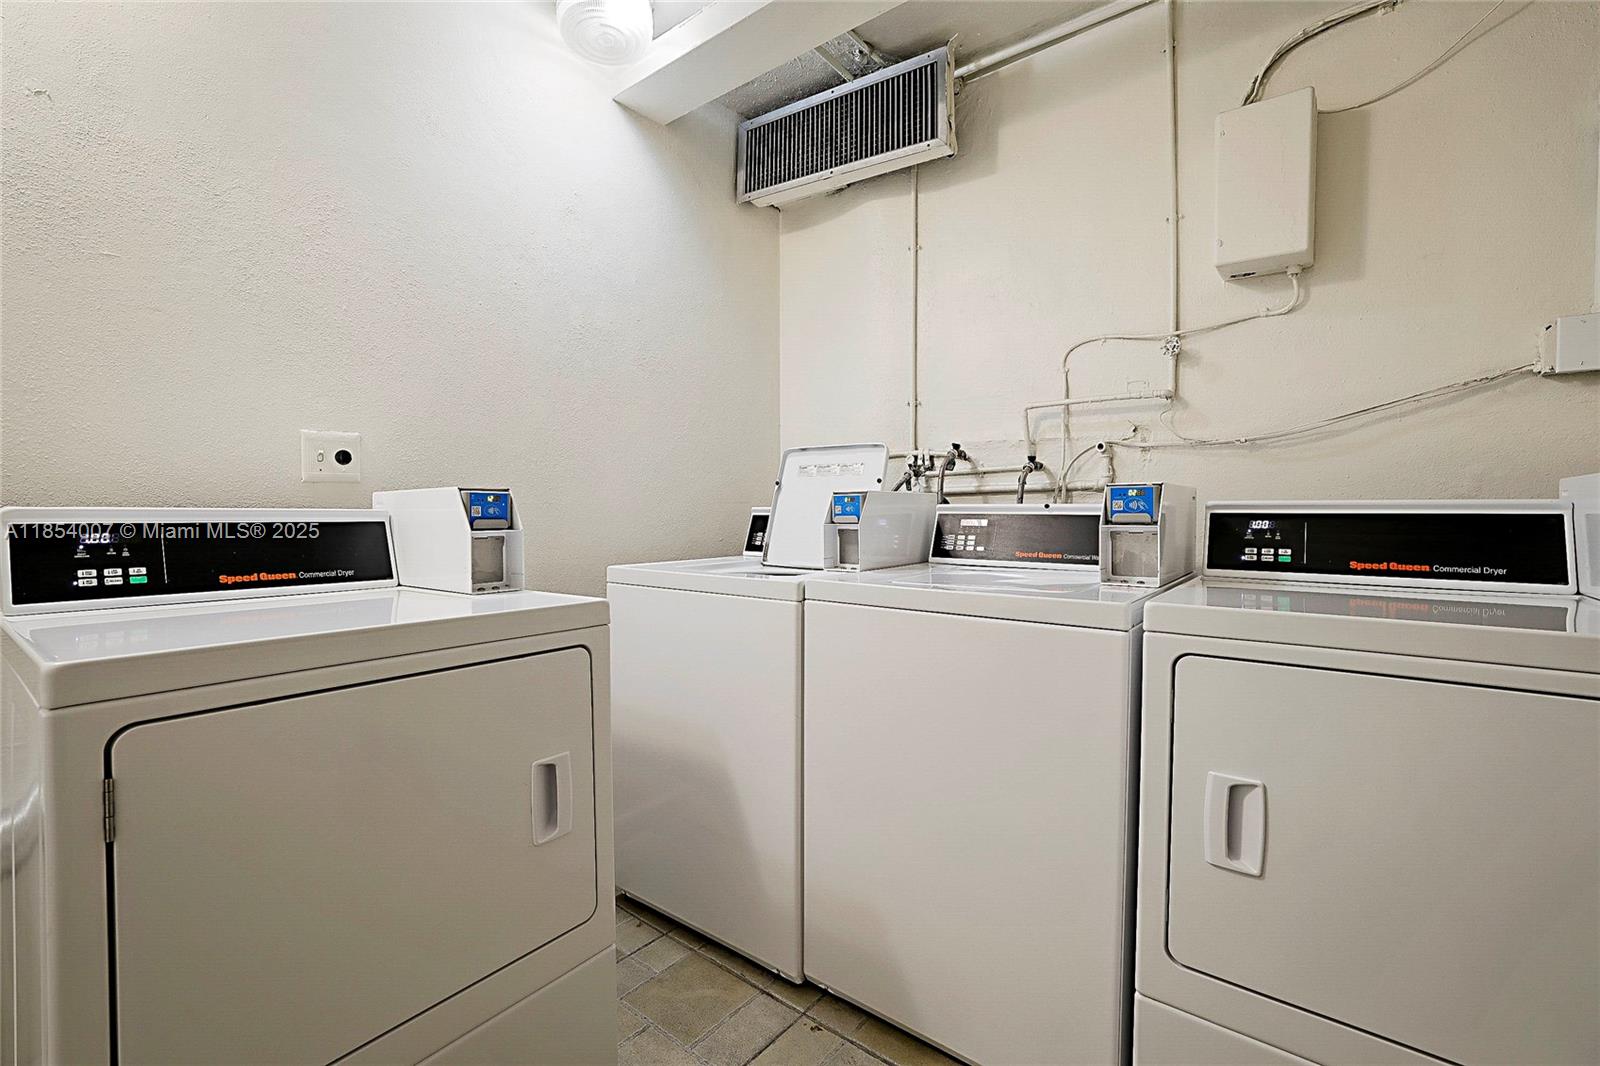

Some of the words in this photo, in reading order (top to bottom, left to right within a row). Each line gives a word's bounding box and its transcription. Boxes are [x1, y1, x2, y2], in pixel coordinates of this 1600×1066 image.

[1016, 551, 1038, 559] Speed
[1038, 551, 1063, 560] Queen
[1349, 560, 1387, 569] Speed
[1389, 561, 1430, 571] Queen
[1433, 564, 1481, 574] Commercial
[1483, 566, 1507, 576] Dryer
[219, 573, 258, 584] Speed
[259, 571, 296, 580] Queen
[298, 570, 337, 579] Commercial
[338, 569, 355, 578] Dryer
